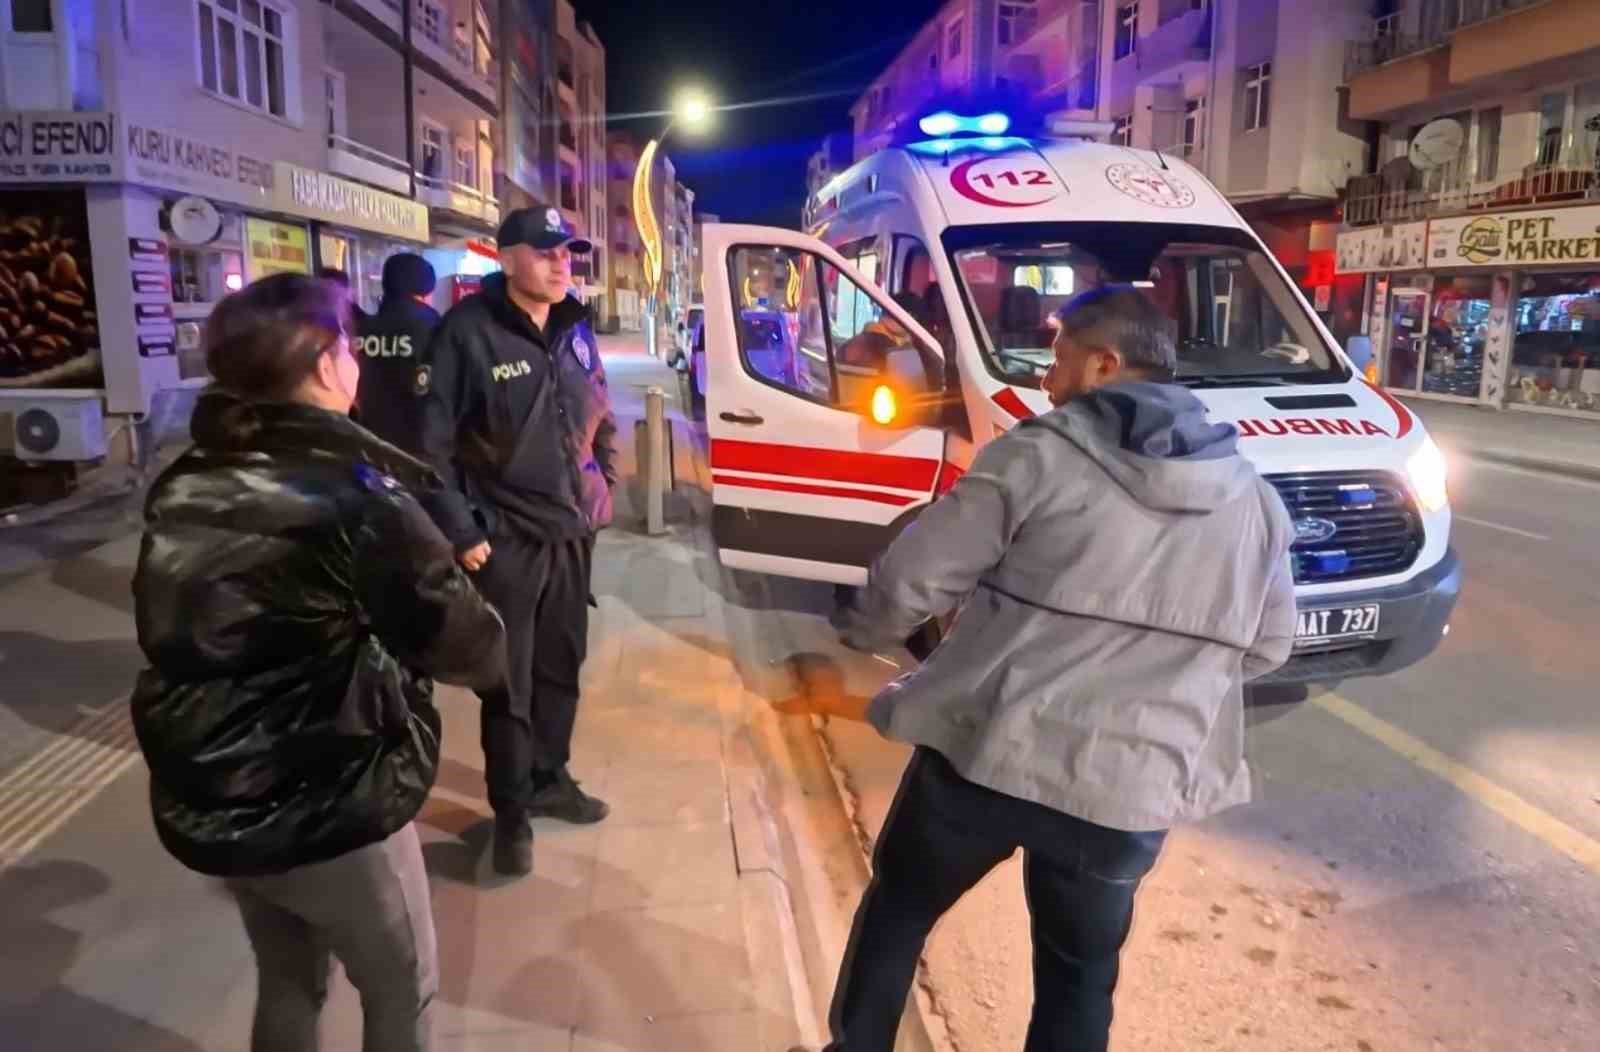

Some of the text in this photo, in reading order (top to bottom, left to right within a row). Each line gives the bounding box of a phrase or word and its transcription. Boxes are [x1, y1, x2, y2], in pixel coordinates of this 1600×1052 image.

[31, 113, 114, 155] EFENDİ
[128, 124, 170, 164] KURU
[973, 170, 1052, 189] 112
[1507, 217, 1555, 240] PET
[1505, 238, 1600, 261] MARKET
[1296, 607, 1376, 636] AAT 737
